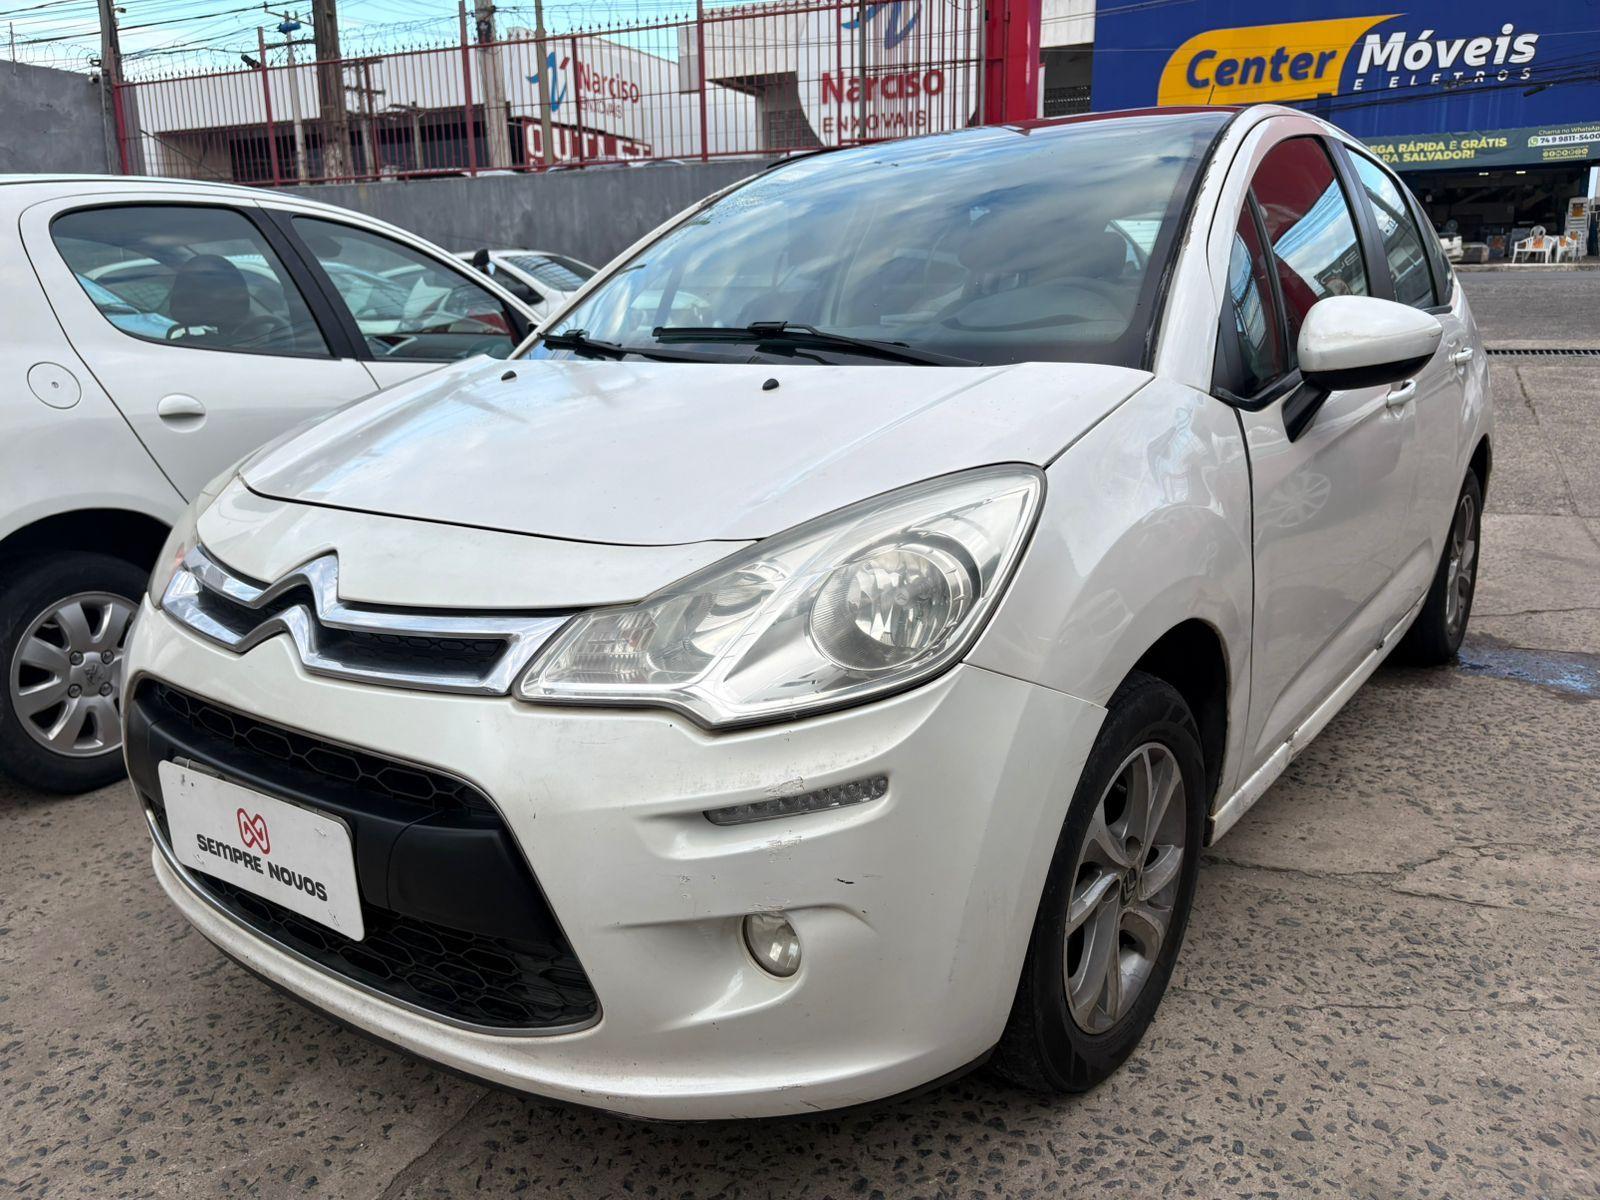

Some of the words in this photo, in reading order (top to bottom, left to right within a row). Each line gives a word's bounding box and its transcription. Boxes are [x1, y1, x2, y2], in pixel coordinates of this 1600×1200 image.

[1186, 46, 1338, 89] Center
[1356, 23, 1540, 75] Móveis
[577, 61, 641, 103] Narciso
[821, 67, 946, 105] Narciso
[1353, 78, 1365, 91] E
[1388, 67, 1532, 89] ELETROS
[1398, 140, 1446, 153] RÁPIDA
[1449, 140, 1458, 150] E
[1460, 136, 1508, 149] GRÁTIS
[196, 833, 265, 875] SEMPRE
